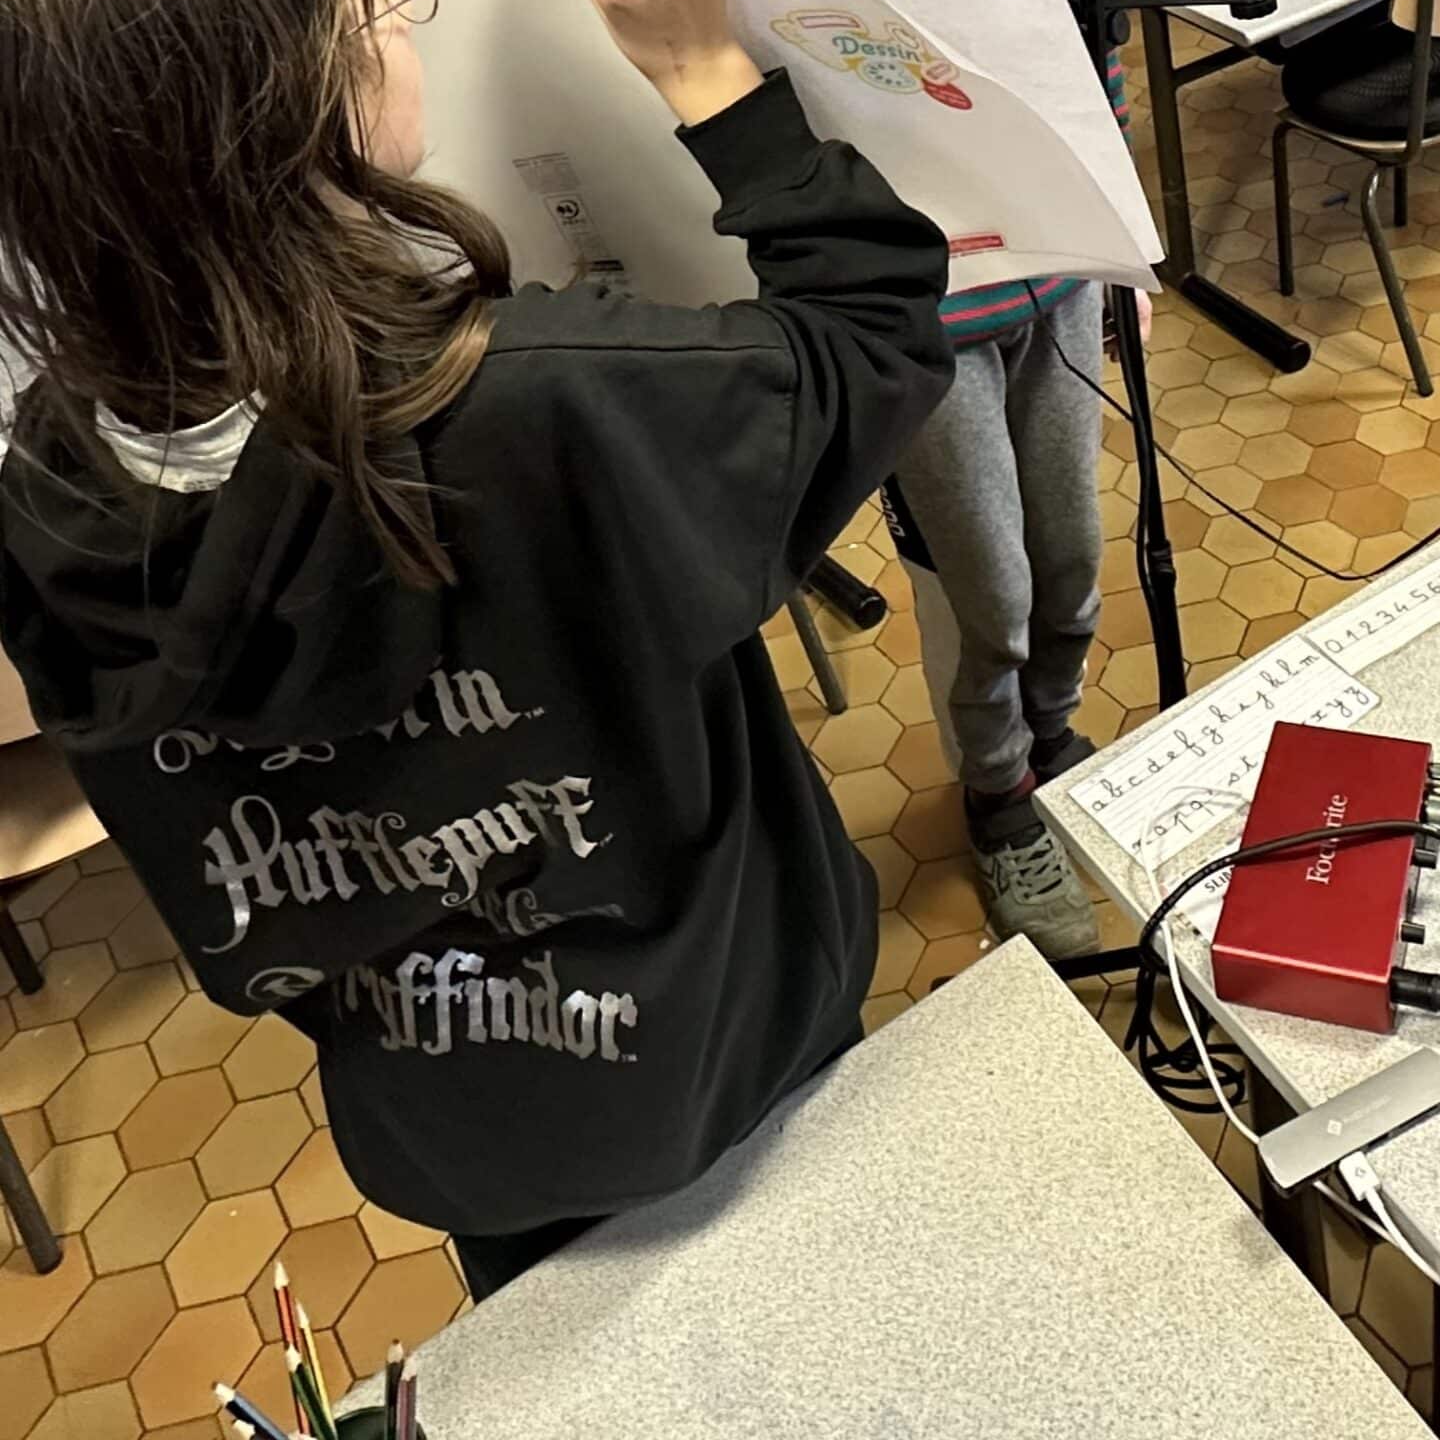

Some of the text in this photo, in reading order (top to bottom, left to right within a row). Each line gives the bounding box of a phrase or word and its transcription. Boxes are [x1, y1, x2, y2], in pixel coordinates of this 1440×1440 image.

[831, 35, 922, 63] Dessin
[1359, 620, 1378, 636] 2
[1376, 609, 1396, 625] 3
[1409, 588, 1430, 603] 5
[200, 774, 598, 954] Hufflepuff
[1305, 793, 1349, 885] Focrite
